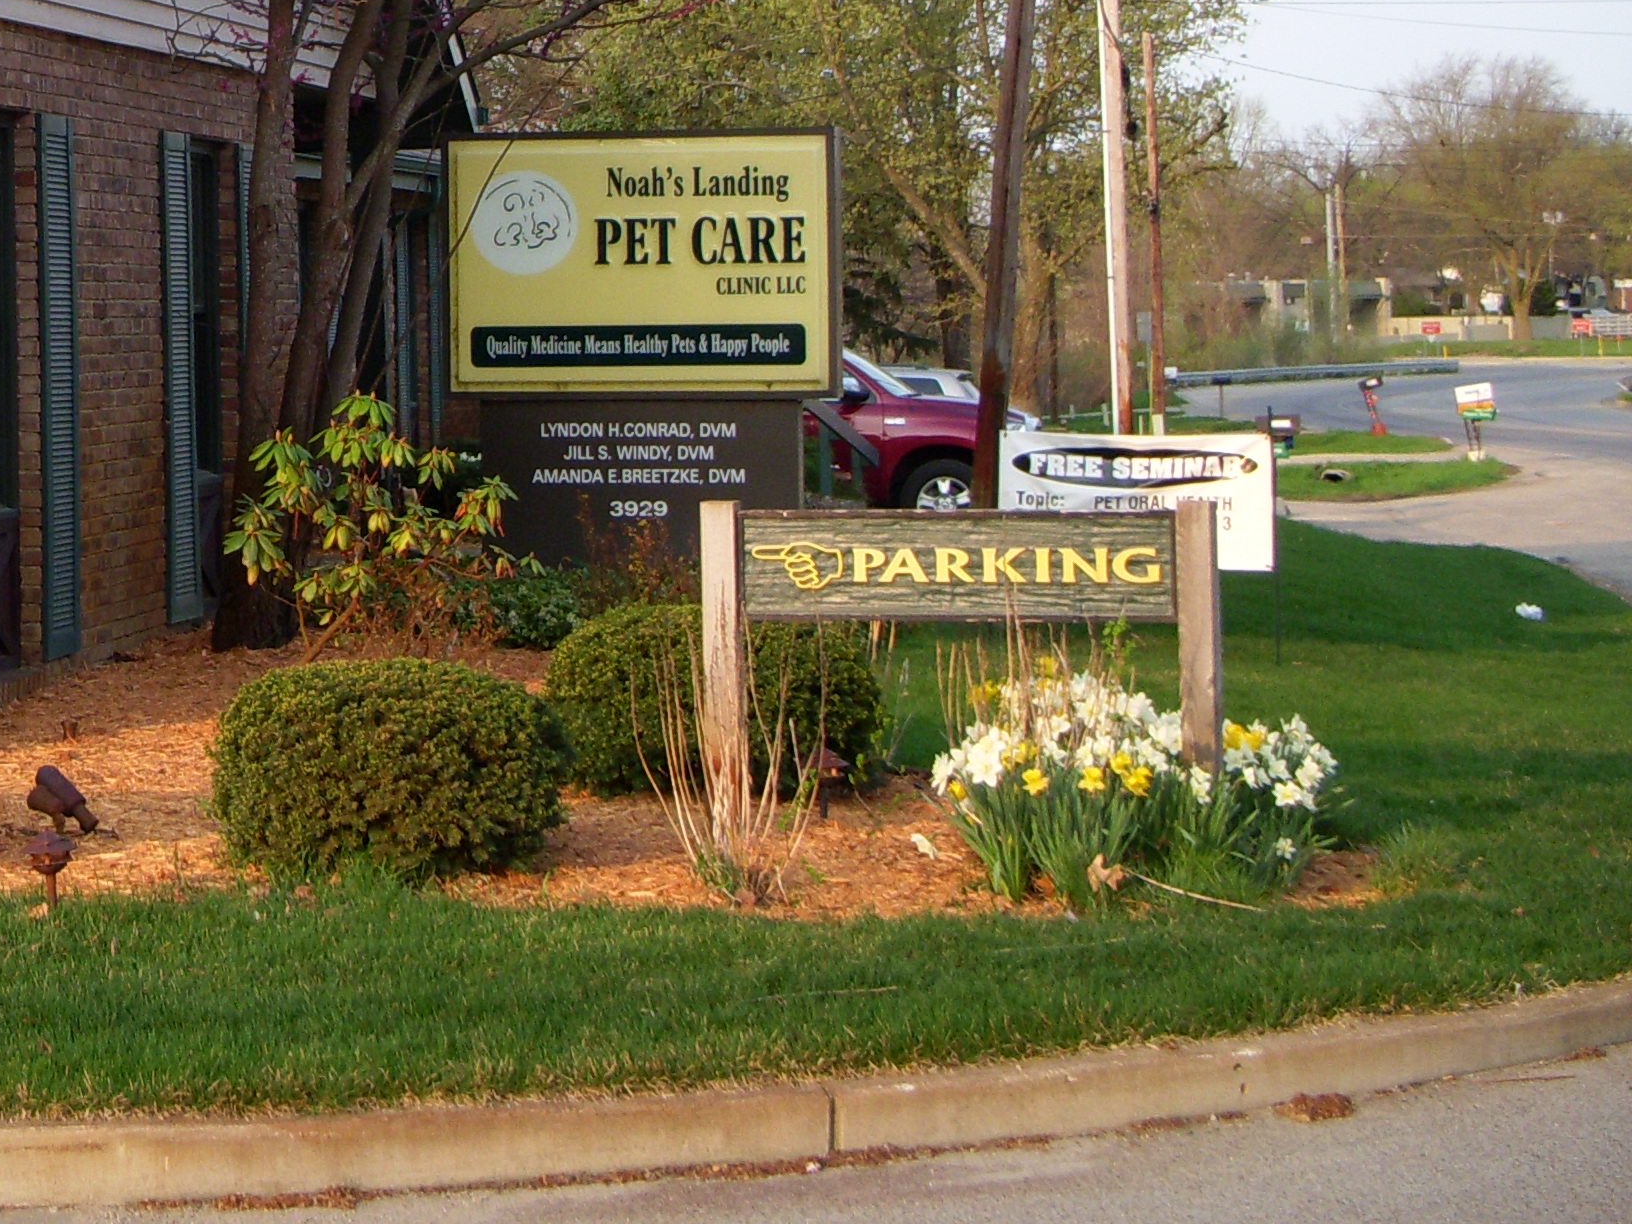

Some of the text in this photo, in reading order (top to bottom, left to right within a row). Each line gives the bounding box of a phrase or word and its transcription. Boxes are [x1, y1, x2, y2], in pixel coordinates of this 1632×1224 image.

[607, 166, 789, 202] Noah's Landing
[594, 216, 806, 266] PET CARE
[716, 276, 806, 295] CLINIC LLC
[486, 333, 790, 358] Quality Medicine Means Healthy Pets & Happy People
[540, 423, 736, 439] LYNDON H.CONRAD, DVM
[563, 446, 714, 462] JILL S. WINDY, DVM
[1028, 453, 1105, 478] FREE
[532, 469, 603, 484] AMANDA
[708, 469, 745, 484] DVM
[609, 501, 668, 517] 3929
[1016, 490, 1065, 509] Topic:
[1094, 495, 1123, 509] PET
[1128, 495, 1167, 510] ORAL
[852, 546, 1162, 585] PARKING
